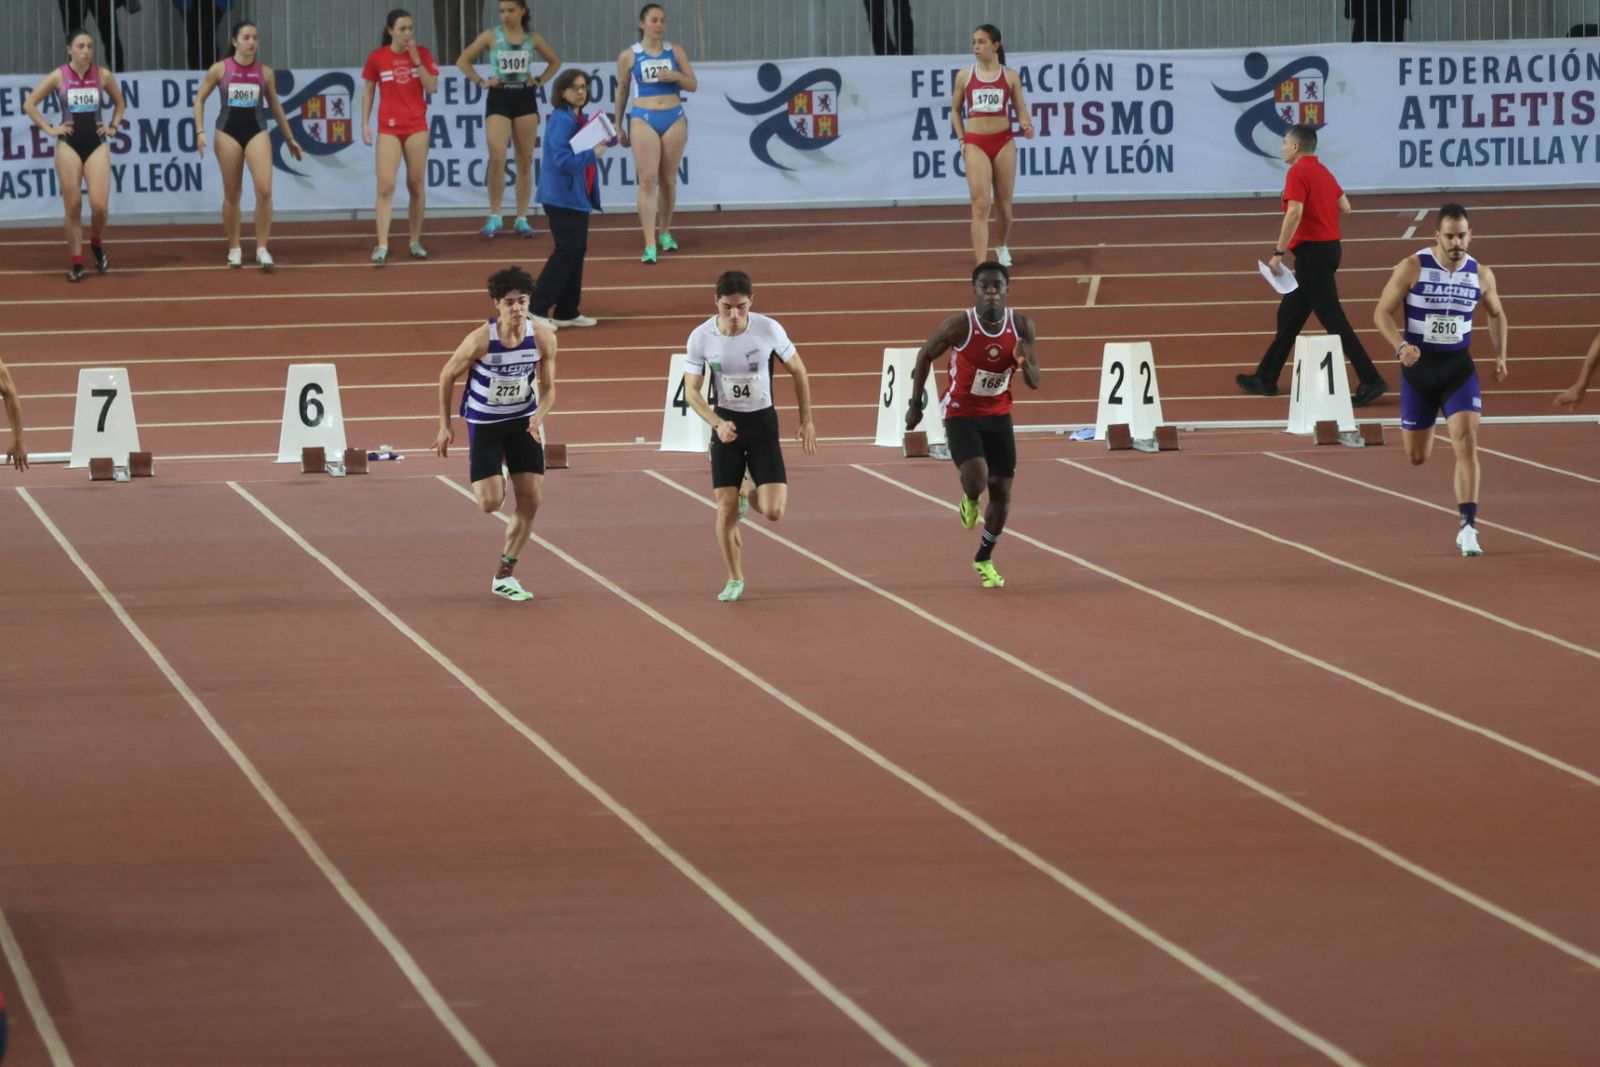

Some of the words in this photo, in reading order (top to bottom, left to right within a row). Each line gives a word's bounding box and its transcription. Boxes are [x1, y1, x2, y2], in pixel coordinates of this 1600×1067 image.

[501, 58, 526, 70] 3101
[911, 58, 1114, 98] FEACIÓN
[1136, 63, 1174, 91] DE
[1399, 47, 1600, 86] FEDERACIÓN
[73, 94, 94, 105] 2104
[234, 90, 254, 100] 2061
[978, 94, 999, 105] 1700
[1399, 90, 1596, 130] ATLETIS
[1, 118, 198, 160] LESMO
[912, 100, 1174, 140] ATETISMO
[913, 150, 946, 178] DE
[953, 144, 1076, 177] CILLA
[1083, 146, 1099, 175] Y
[1106, 139, 1174, 174] LEÓN
[1399, 139, 1433, 169] DE
[1440, 135, 1565, 168] CASTILLA
[1571, 134, 1589, 164] Y
[111, 164, 126, 193] Y
[134, 157, 202, 192] LEÓN
[428, 158, 461, 187] DE
[597, 157, 613, 186] Y
[1422, 284, 1477, 299] RACING
[1431, 321, 1457, 334] 2610
[495, 385, 520, 397] 2721
[733, 384, 751, 398] 94
[884, 364, 895, 408] 3
[1108, 361, 1124, 404] 2
[1140, 361, 1154, 404] 2
[1321, 352, 1334, 395] 1
[91, 389, 117, 432] 7
[299, 383, 324, 427] 6
[673, 374, 690, 416] 4
